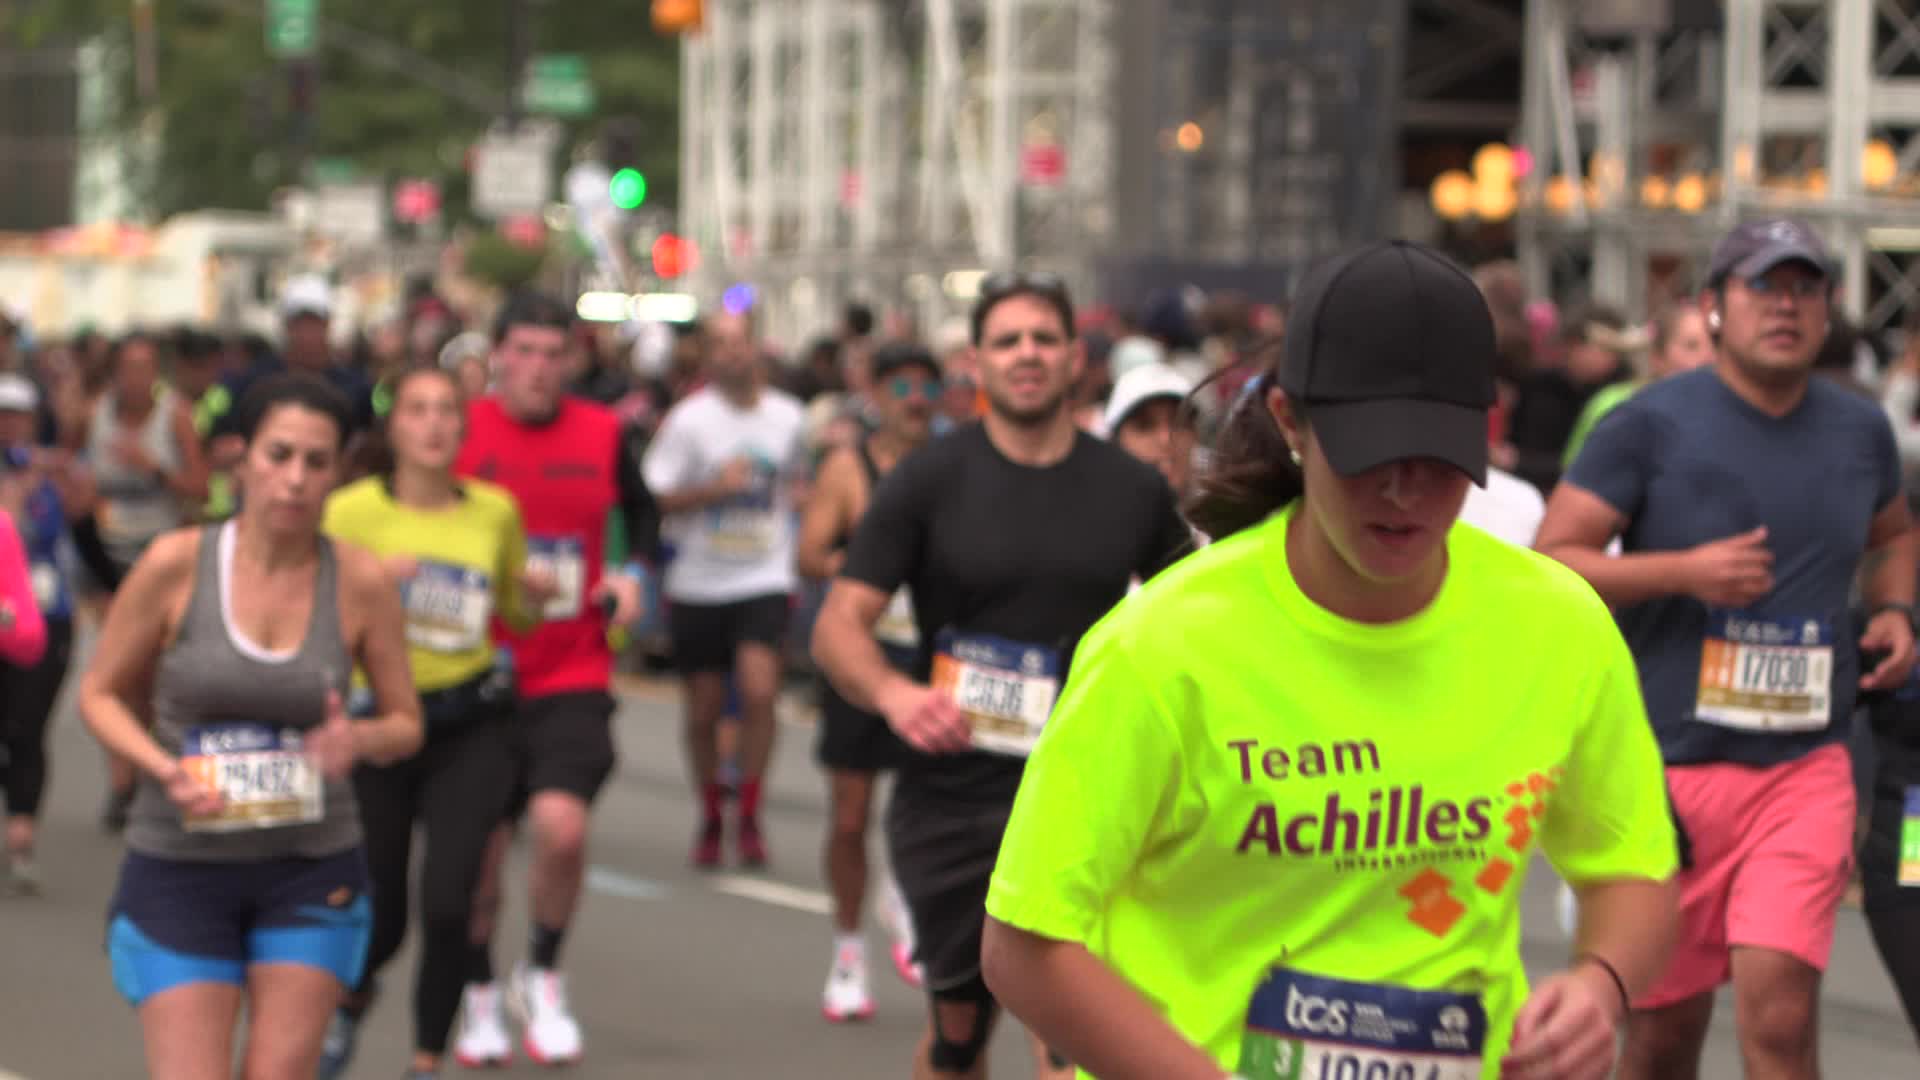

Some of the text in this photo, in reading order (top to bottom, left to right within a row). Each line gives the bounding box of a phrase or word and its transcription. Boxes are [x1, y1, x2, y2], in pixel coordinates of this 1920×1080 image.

[1743, 652, 1809, 690] 17030
[1227, 738, 1381, 785] Team
[1234, 783, 1492, 858] Achilles
[1285, 982, 1349, 1036] tcs
